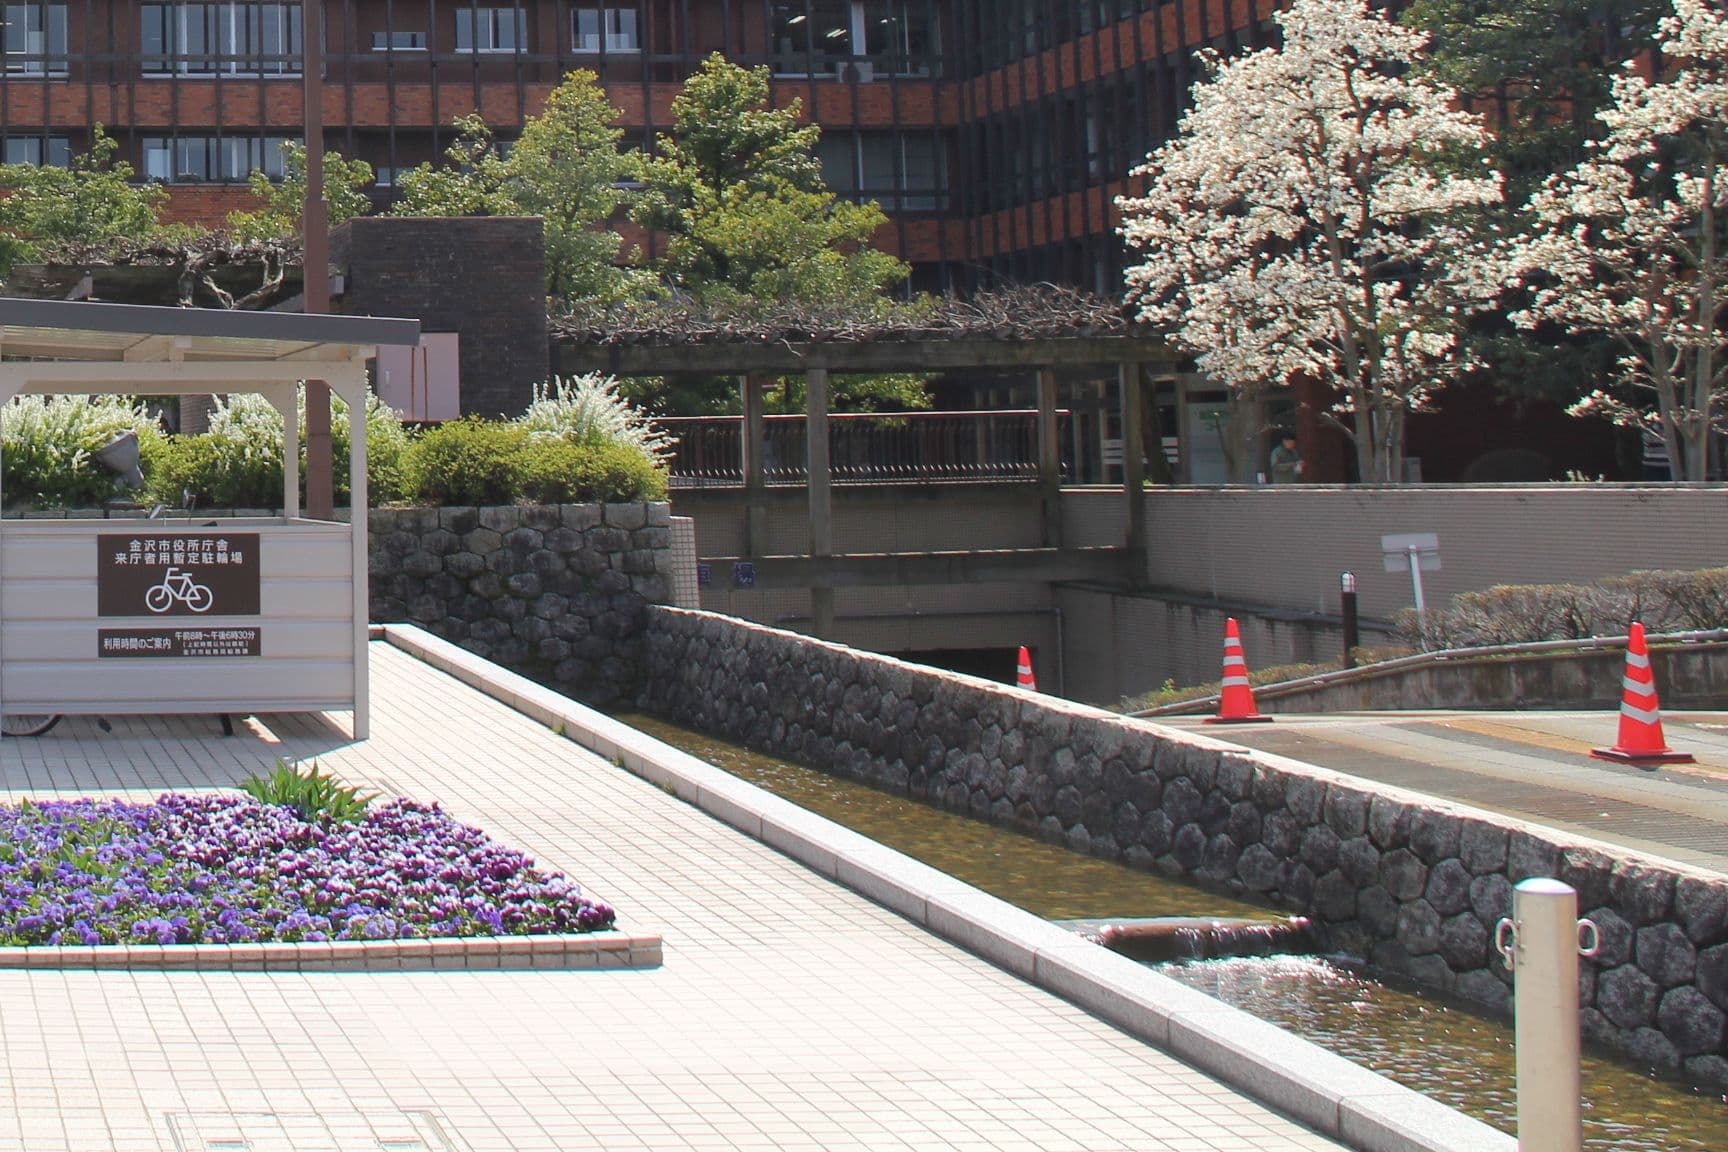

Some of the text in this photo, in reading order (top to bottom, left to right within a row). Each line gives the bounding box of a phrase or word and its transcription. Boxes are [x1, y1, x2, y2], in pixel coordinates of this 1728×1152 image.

[129, 539, 229, 552] 金沢市役所庁舎
[115, 551, 243, 565] 来庁者用暫定駐輪場
[103, 637, 172, 650] 利用時間のご案内
